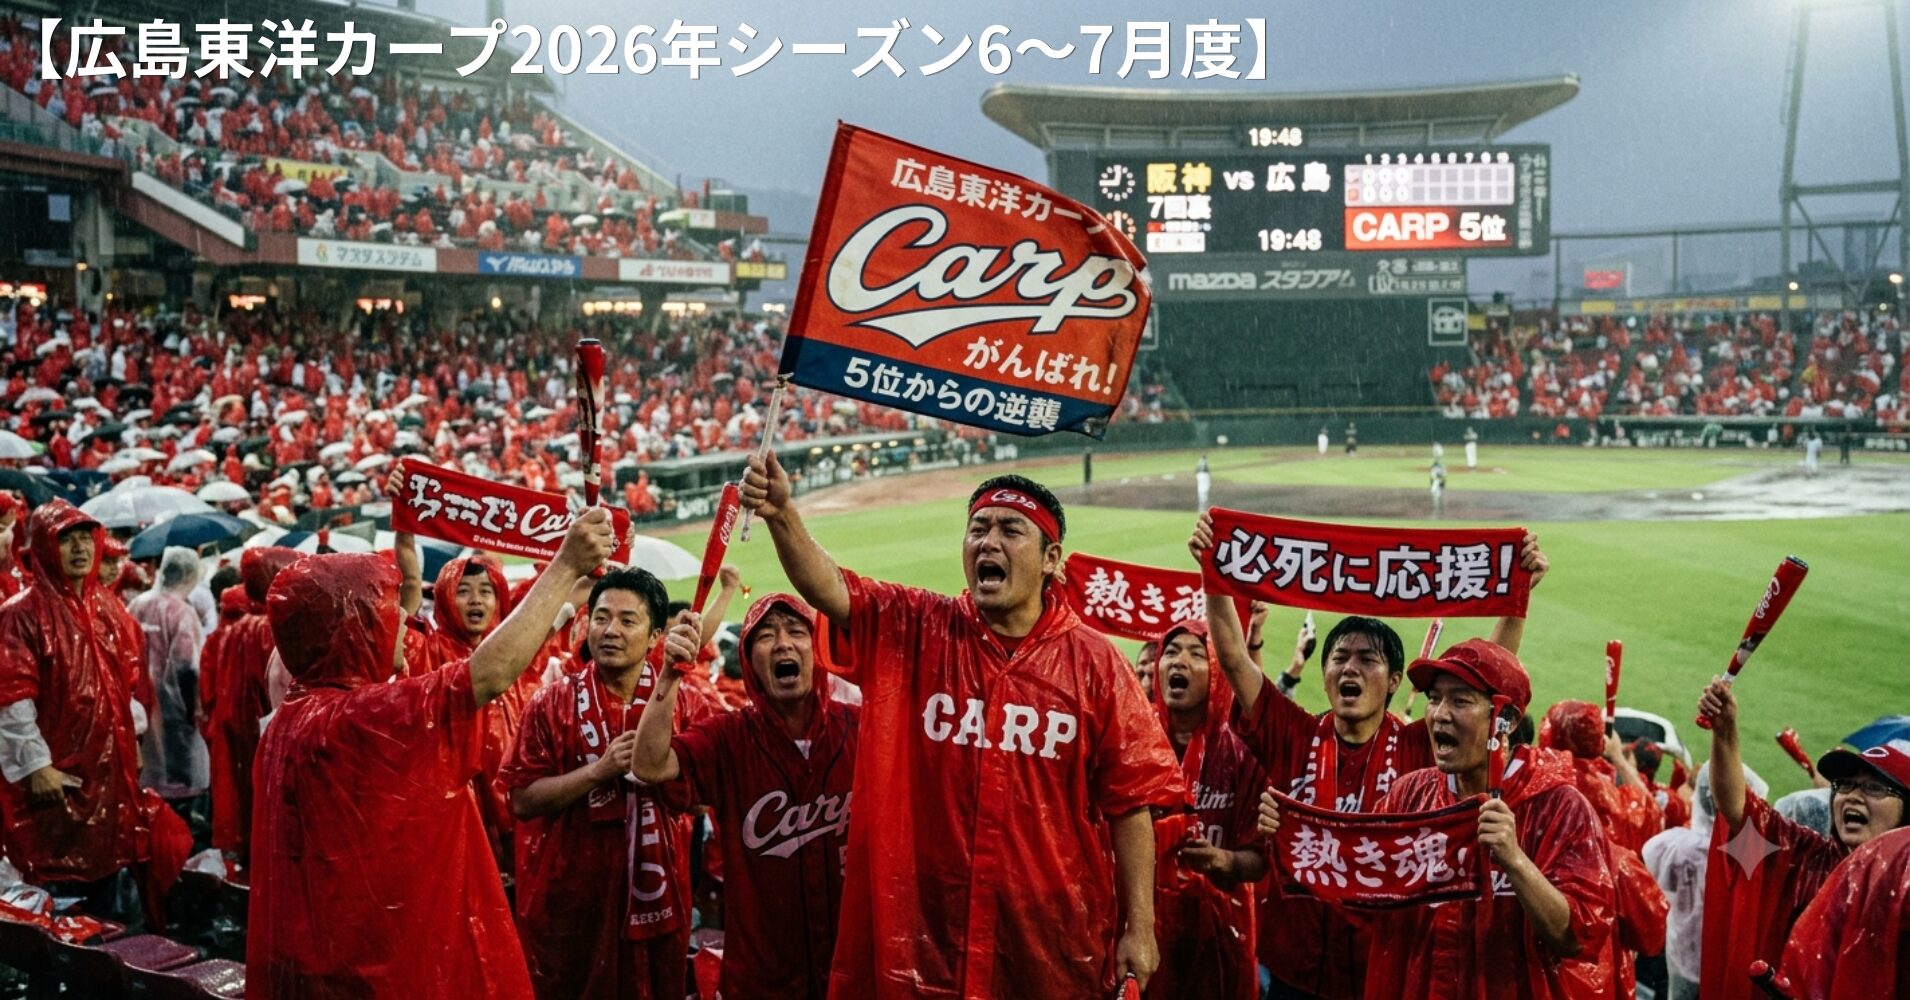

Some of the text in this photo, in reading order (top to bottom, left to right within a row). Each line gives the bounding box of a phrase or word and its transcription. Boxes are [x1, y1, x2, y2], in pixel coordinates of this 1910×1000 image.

[1249, 127, 1303, 147] 19:48
[1258, 228, 1322, 251] 19:48
[1353, 212, 1450, 241] CARP
[826, 203, 1138, 350] Carp
[1169, 272, 1257, 291] mazda
[843, 357, 1062, 432] 5位からの逆襲
[520, 504, 572, 542] Car
[1215, 527, 1514, 601] 必死に応援!
[922, 693, 1077, 759] CARP
[1290, 824, 1467, 888] 熱き魂!
